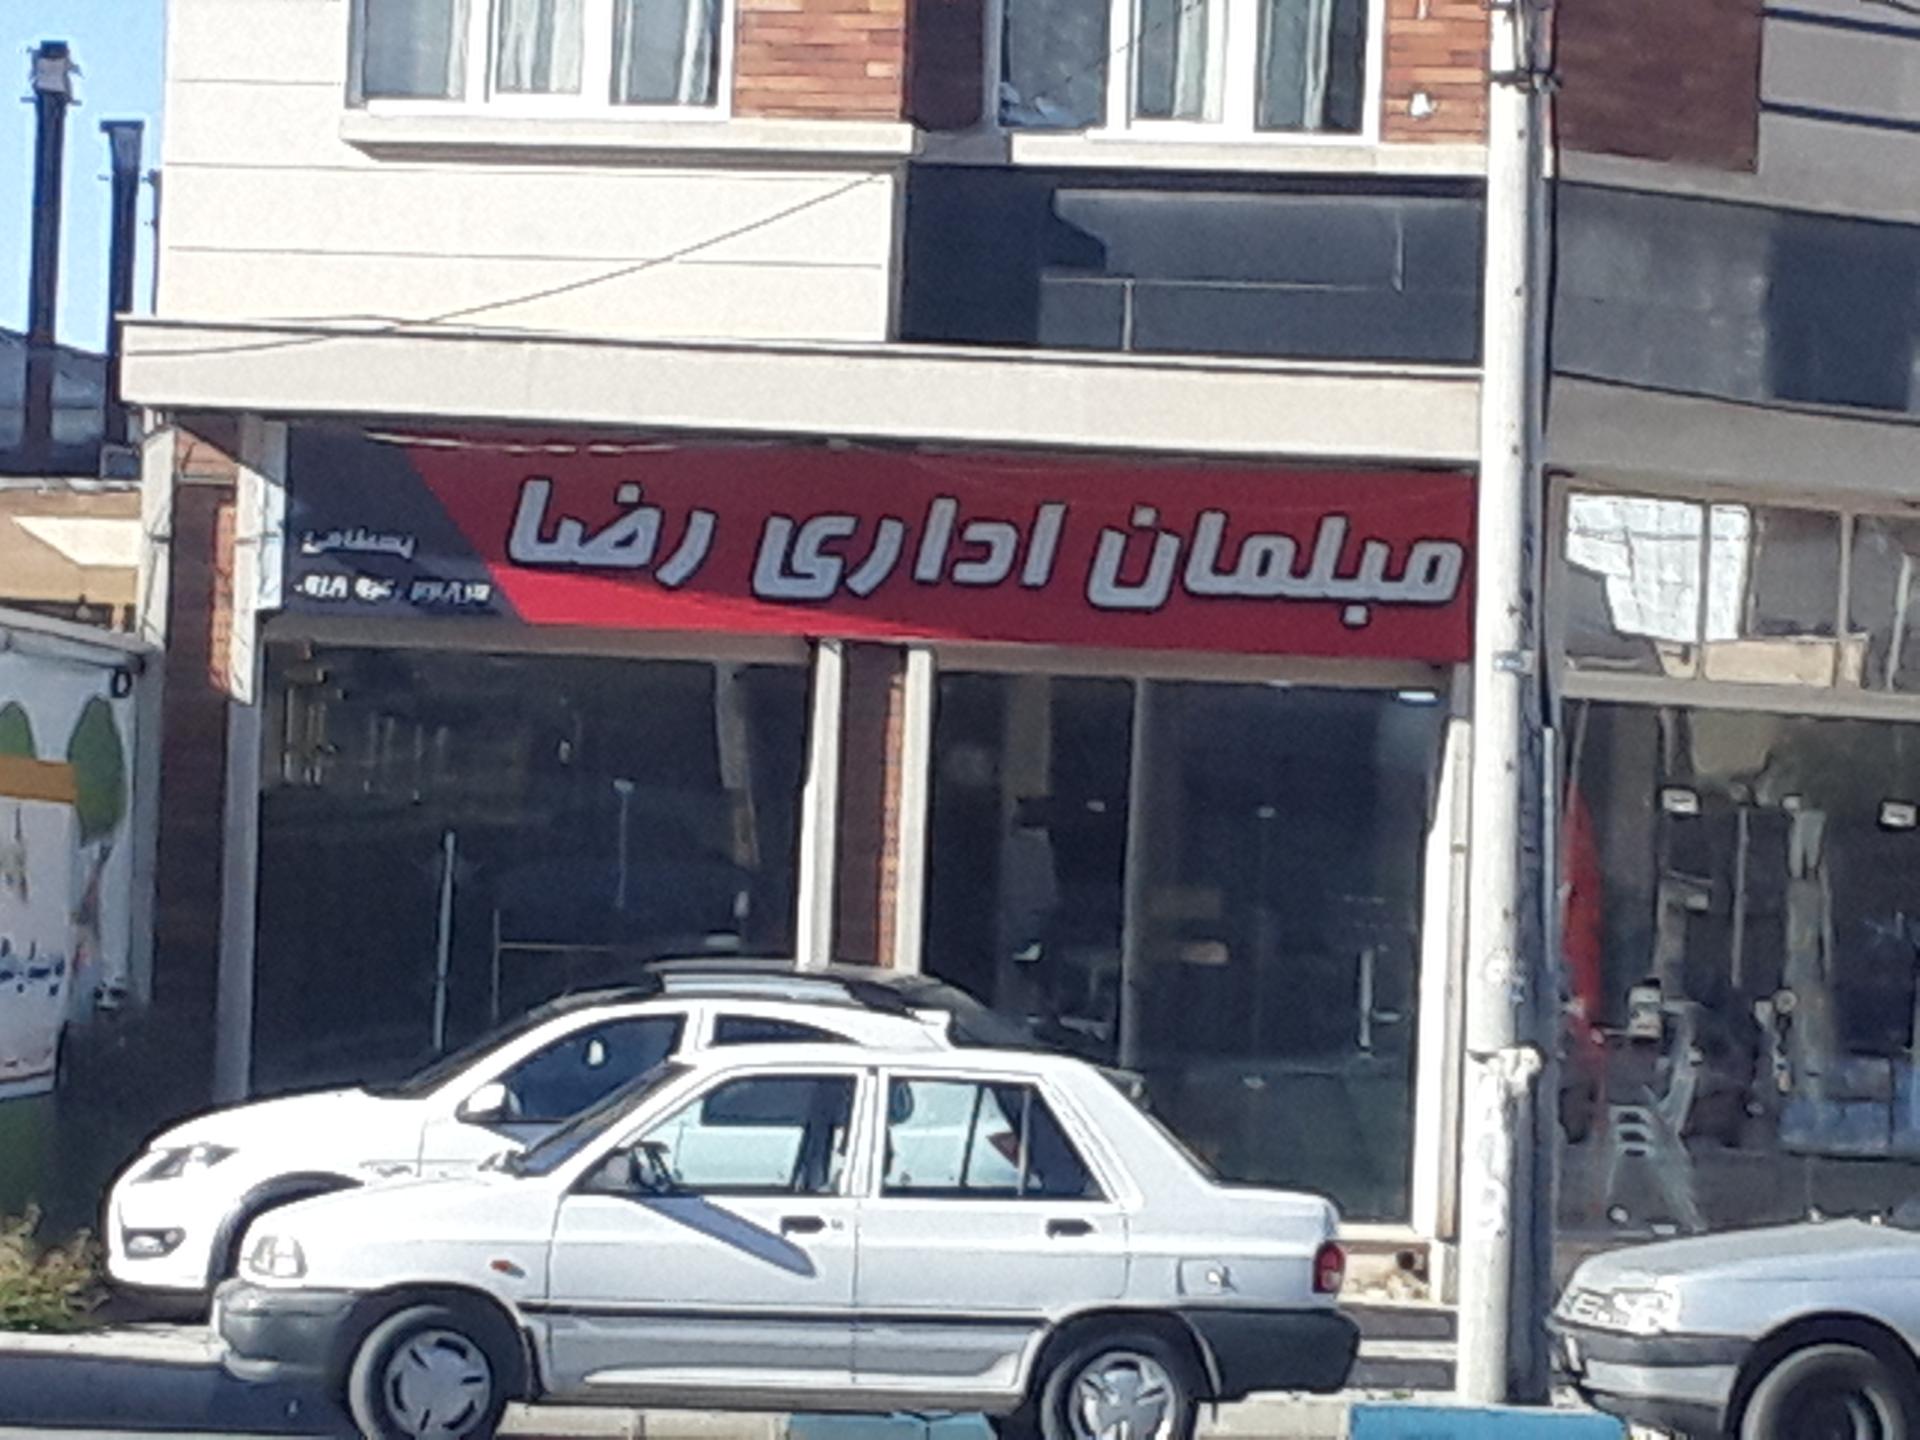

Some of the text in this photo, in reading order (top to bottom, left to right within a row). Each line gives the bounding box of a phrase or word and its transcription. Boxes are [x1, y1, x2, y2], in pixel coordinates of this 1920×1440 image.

[509, 478, 1464, 628] مبلمان اداری رضا
